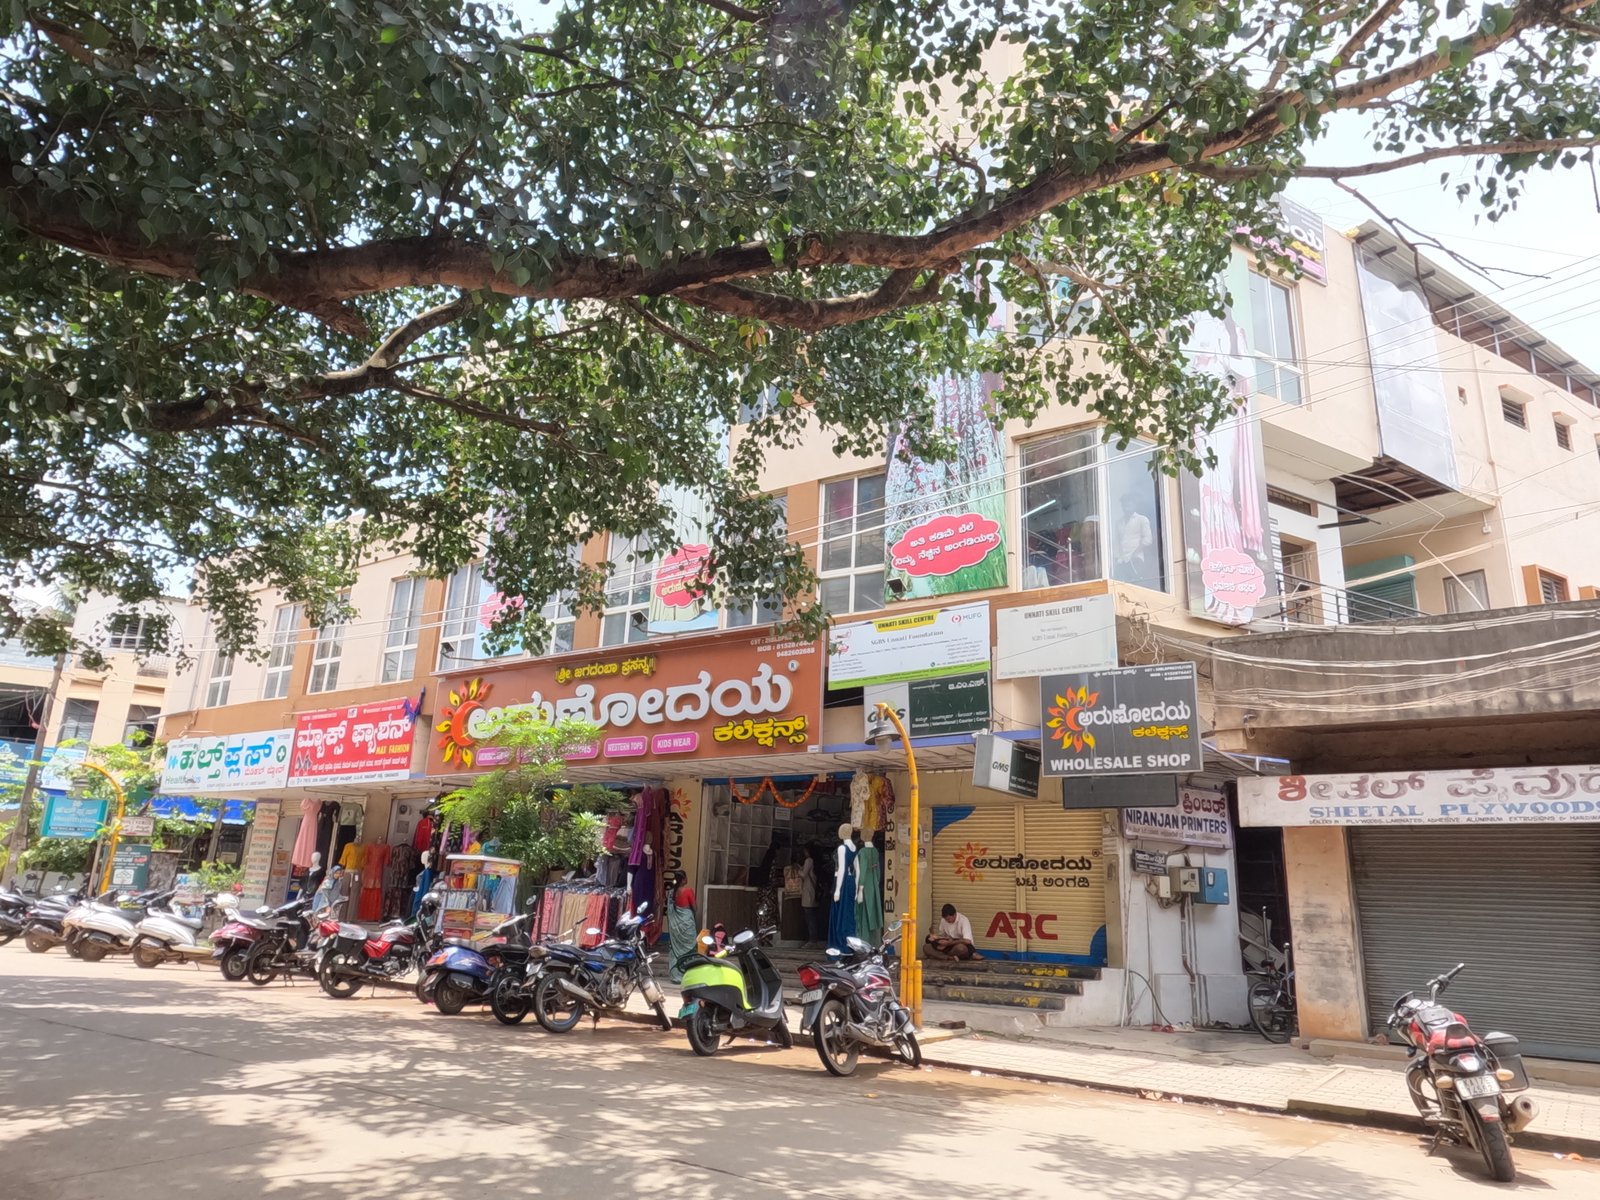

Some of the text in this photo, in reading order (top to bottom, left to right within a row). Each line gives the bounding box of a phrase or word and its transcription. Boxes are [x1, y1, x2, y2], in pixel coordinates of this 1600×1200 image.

[898, 617, 913, 626] SKILL
[913, 614, 935, 624] CENTRE
[1045, 608, 1061, 617] SKILL
[1078, 699, 1191, 727] ಅರುಣೋದಯ
[1132, 724, 1189, 740] ಕಲೆಕ್ಷನ್ಸ್
[630, 740, 644, 751] TOPS
[656, 737, 692, 749] KIDS WEAR
[992, 761, 1009, 773] GMS
[1050, 755, 1143, 772] WHOLESALE
[1147, 753, 1191, 767] SHOP
[1277, 772, 1425, 802] ಶೀತಲ್
[1309, 801, 1600, 818] SHEETAL PLYWOOD
[1125, 808, 1179, 829] NIRANJAN
[1181, 816, 1227, 834] PRINTERS
[972, 853, 1092, 871] ಅರುಣೋದಯ
[1015, 874, 1090, 891] ಬಟ್ಟೆ ಅಂಗಡಿ
[985, 911, 1058, 940] ARC
